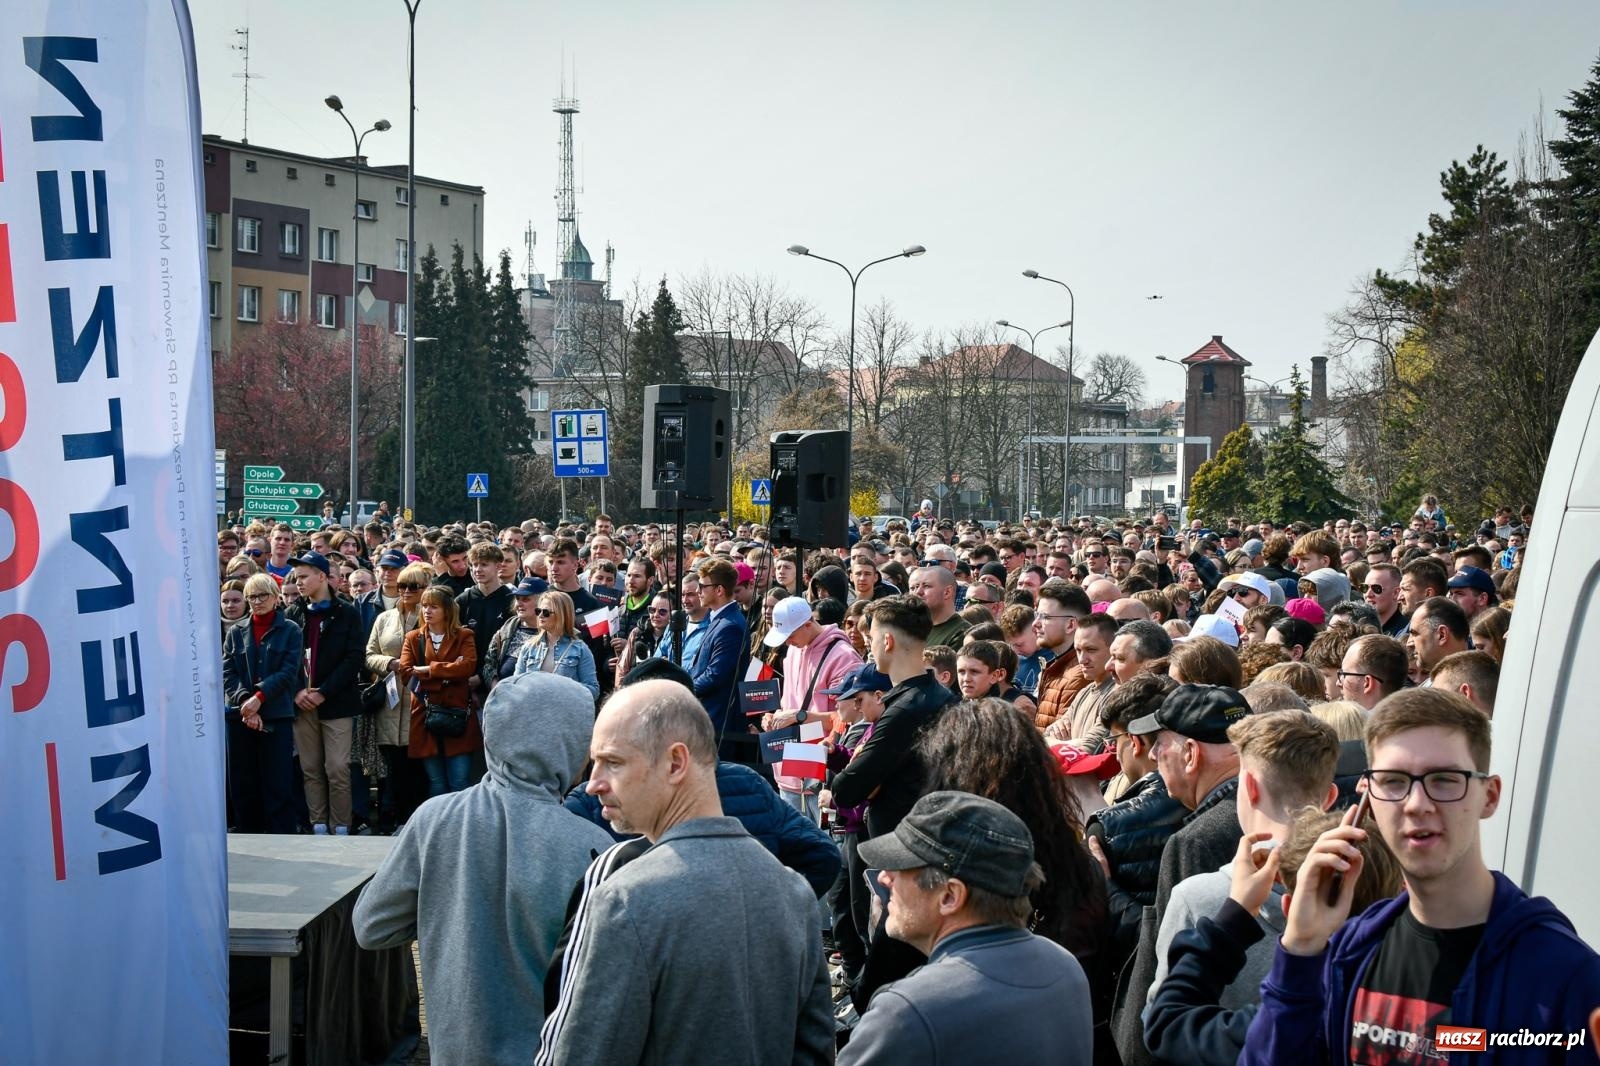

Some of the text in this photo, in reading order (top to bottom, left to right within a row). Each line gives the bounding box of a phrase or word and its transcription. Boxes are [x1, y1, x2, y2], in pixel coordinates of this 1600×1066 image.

[249, 469, 275, 480] Opole
[248, 485, 286, 496] Chałupki
[248, 501, 290, 512] Głubczyce
